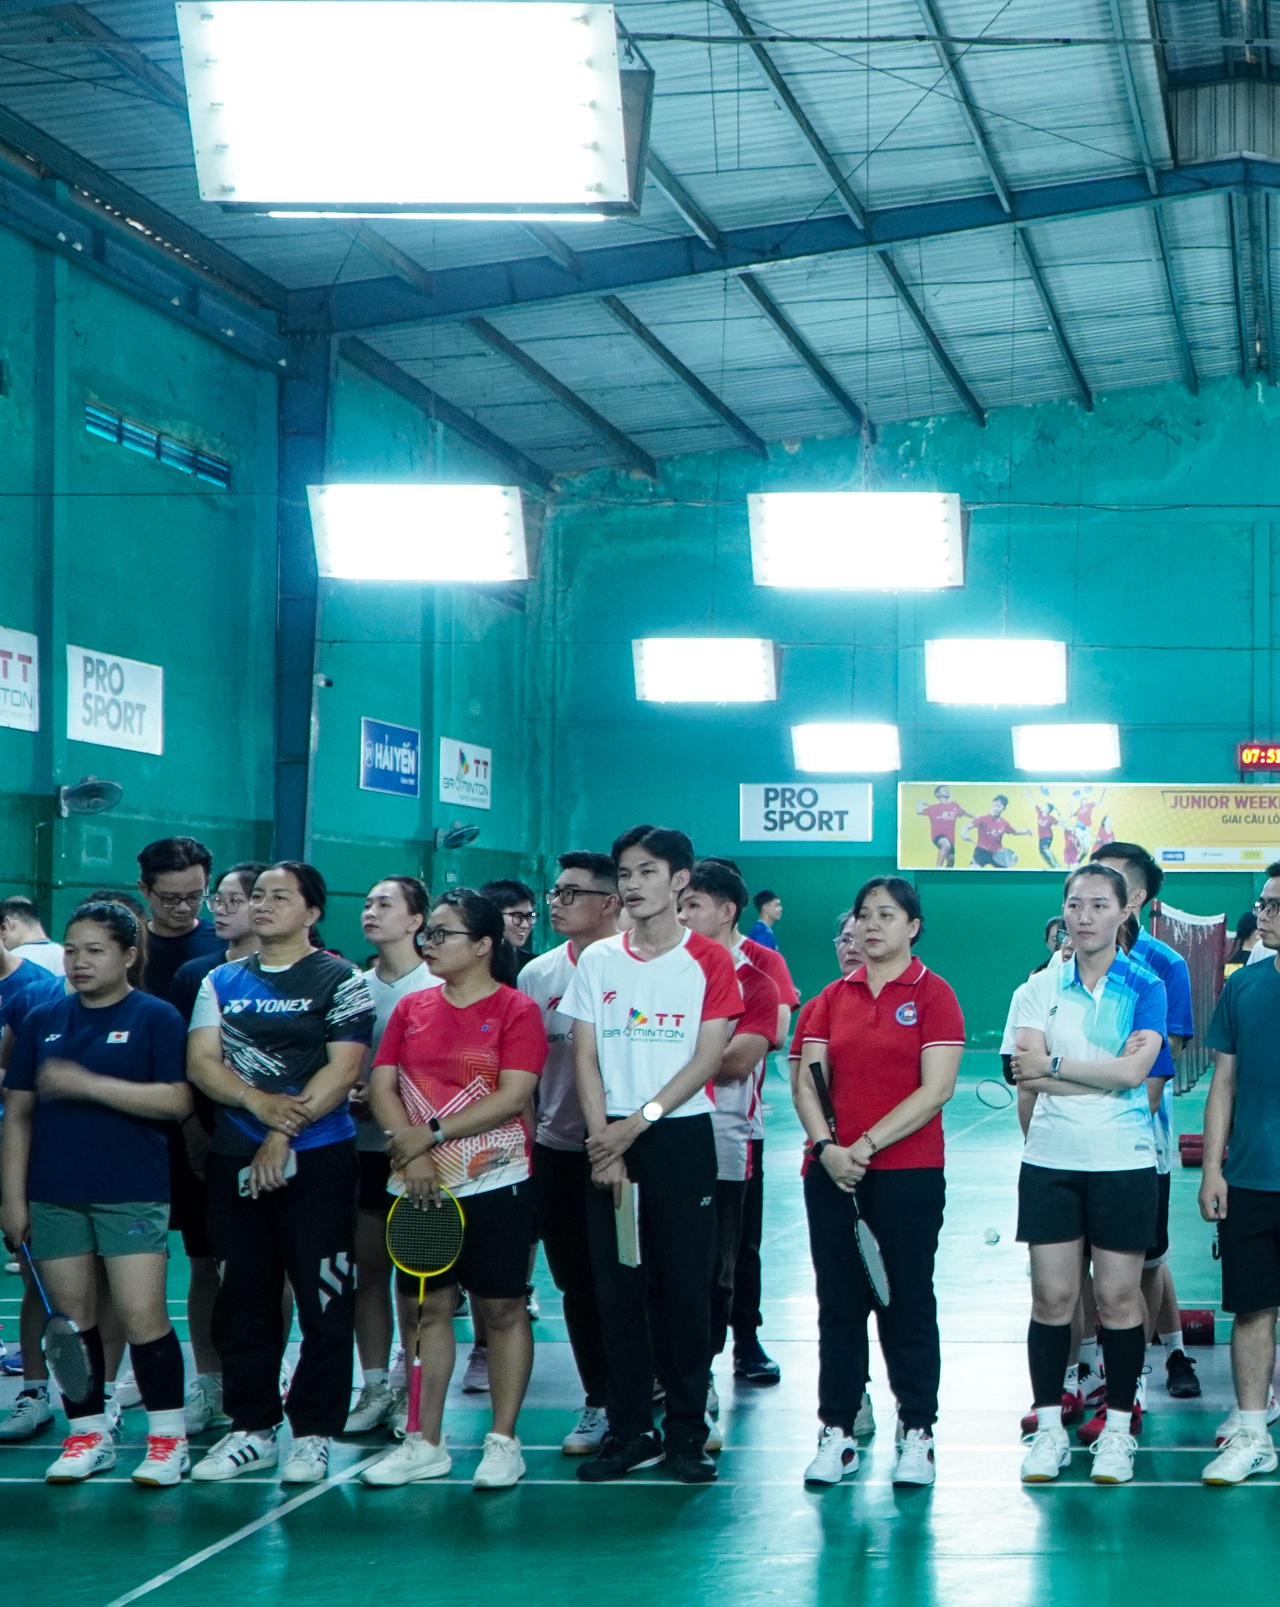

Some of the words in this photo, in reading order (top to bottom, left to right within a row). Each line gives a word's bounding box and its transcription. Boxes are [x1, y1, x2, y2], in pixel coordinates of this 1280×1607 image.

[82, 655, 124, 697] PRO
[82, 692, 146, 736] SPORT
[473, 759, 488, 780] TT
[763, 787, 819, 809] PRO
[1170, 795, 1229, 810] JUNIOR
[763, 810, 849, 832] SPORT
[255, 998, 313, 1013] YONEX
[655, 1013, 685, 1027] TT
[602, 1027, 685, 1038] BADMINTON
